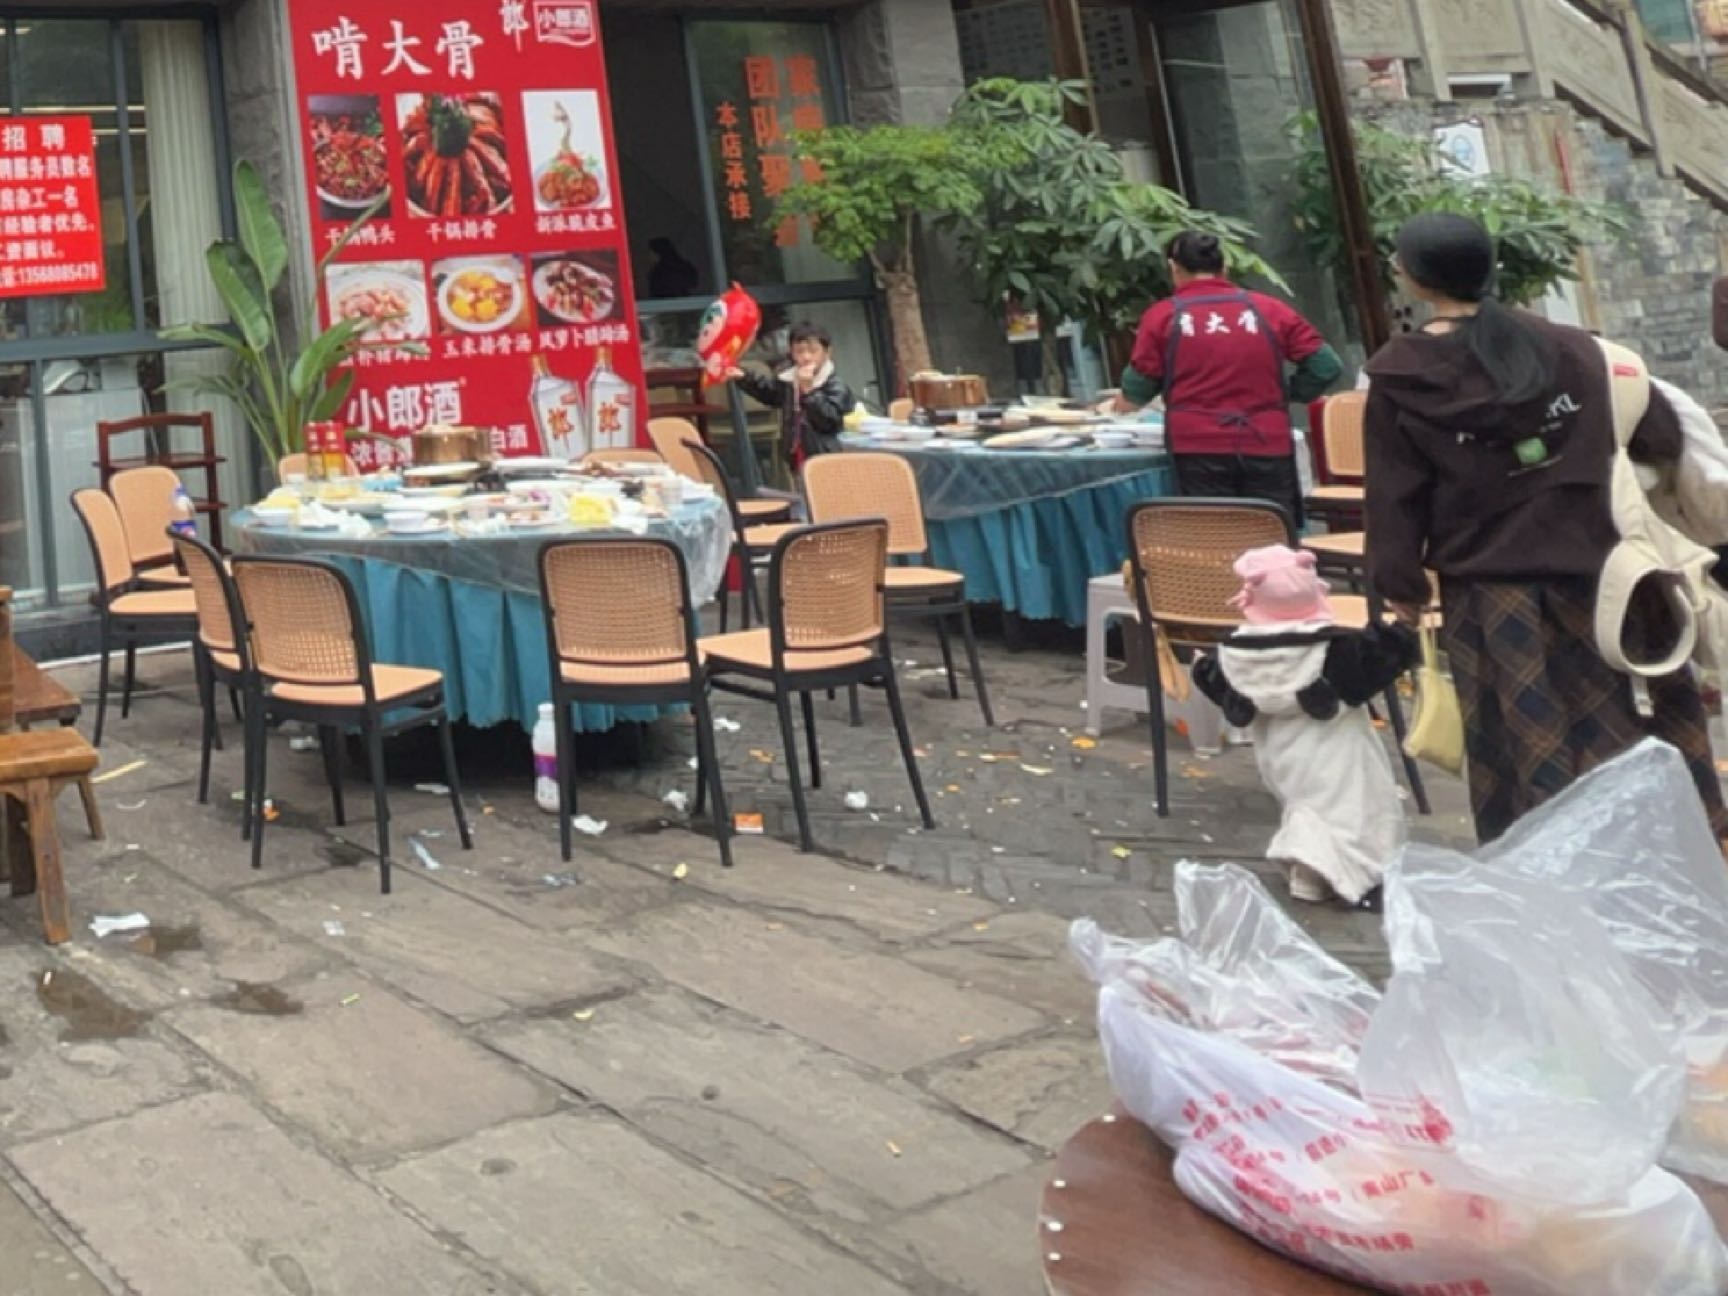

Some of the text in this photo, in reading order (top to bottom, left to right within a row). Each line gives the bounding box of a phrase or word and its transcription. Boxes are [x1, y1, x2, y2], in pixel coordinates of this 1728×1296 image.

[311, 15, 484, 80] 啃大骨
[1, 123, 66, 152] 招聘
[347, 379, 463, 432] 小郎酒
